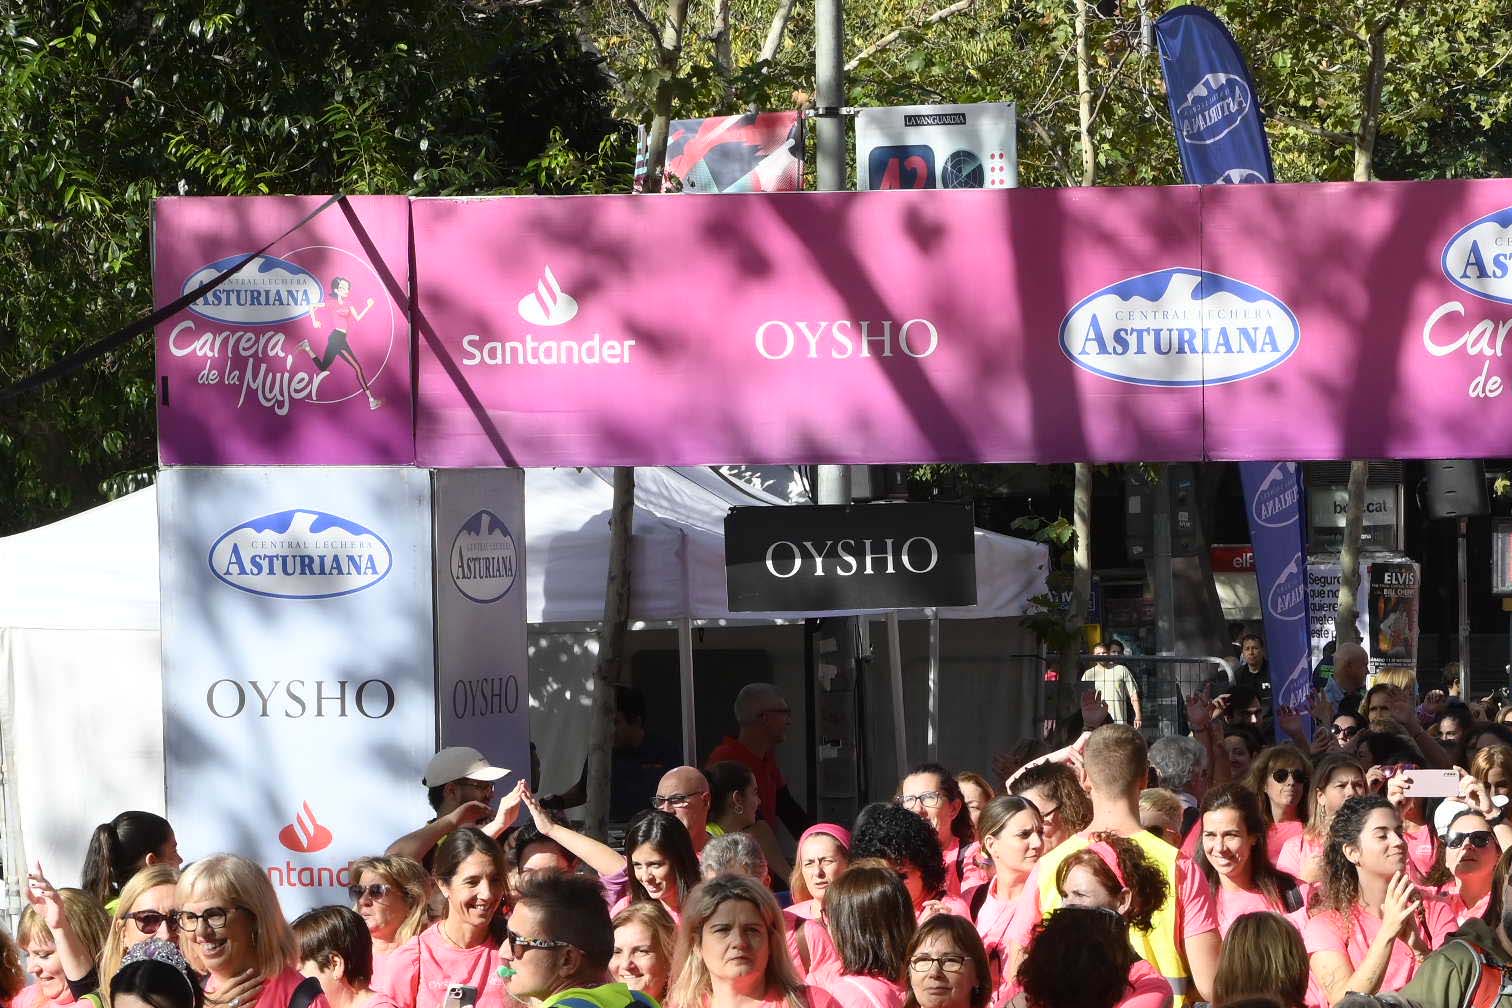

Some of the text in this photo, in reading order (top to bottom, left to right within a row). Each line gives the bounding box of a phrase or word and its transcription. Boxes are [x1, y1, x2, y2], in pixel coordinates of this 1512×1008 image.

[1115, 308, 1272, 321] CENTRAL LECHERA
[168, 320, 286, 357] Carrera
[462, 333, 636, 366] Santander
[755, 318, 939, 360] OYSHO
[1078, 312, 1281, 356] ASTURIANA
[197, 355, 330, 416] de la Mujer
[1469, 359, 1503, 398] de
[223, 542, 380, 577] ASTURIANA
[250, 540, 373, 550] CENTRAL LECHERA
[765, 536, 939, 579] OYSHO
[455, 545, 513, 581] ASTURIANA
[1384, 572, 1414, 584] ELVIS
[1309, 589, 1327, 600] que
[1310, 601, 1342, 613] quiere
[1311, 628, 1329, 639] este
[206, 679, 395, 719] OYSHO
[453, 674, 519, 719] OYSHO
[267, 860, 351, 888] ntand
